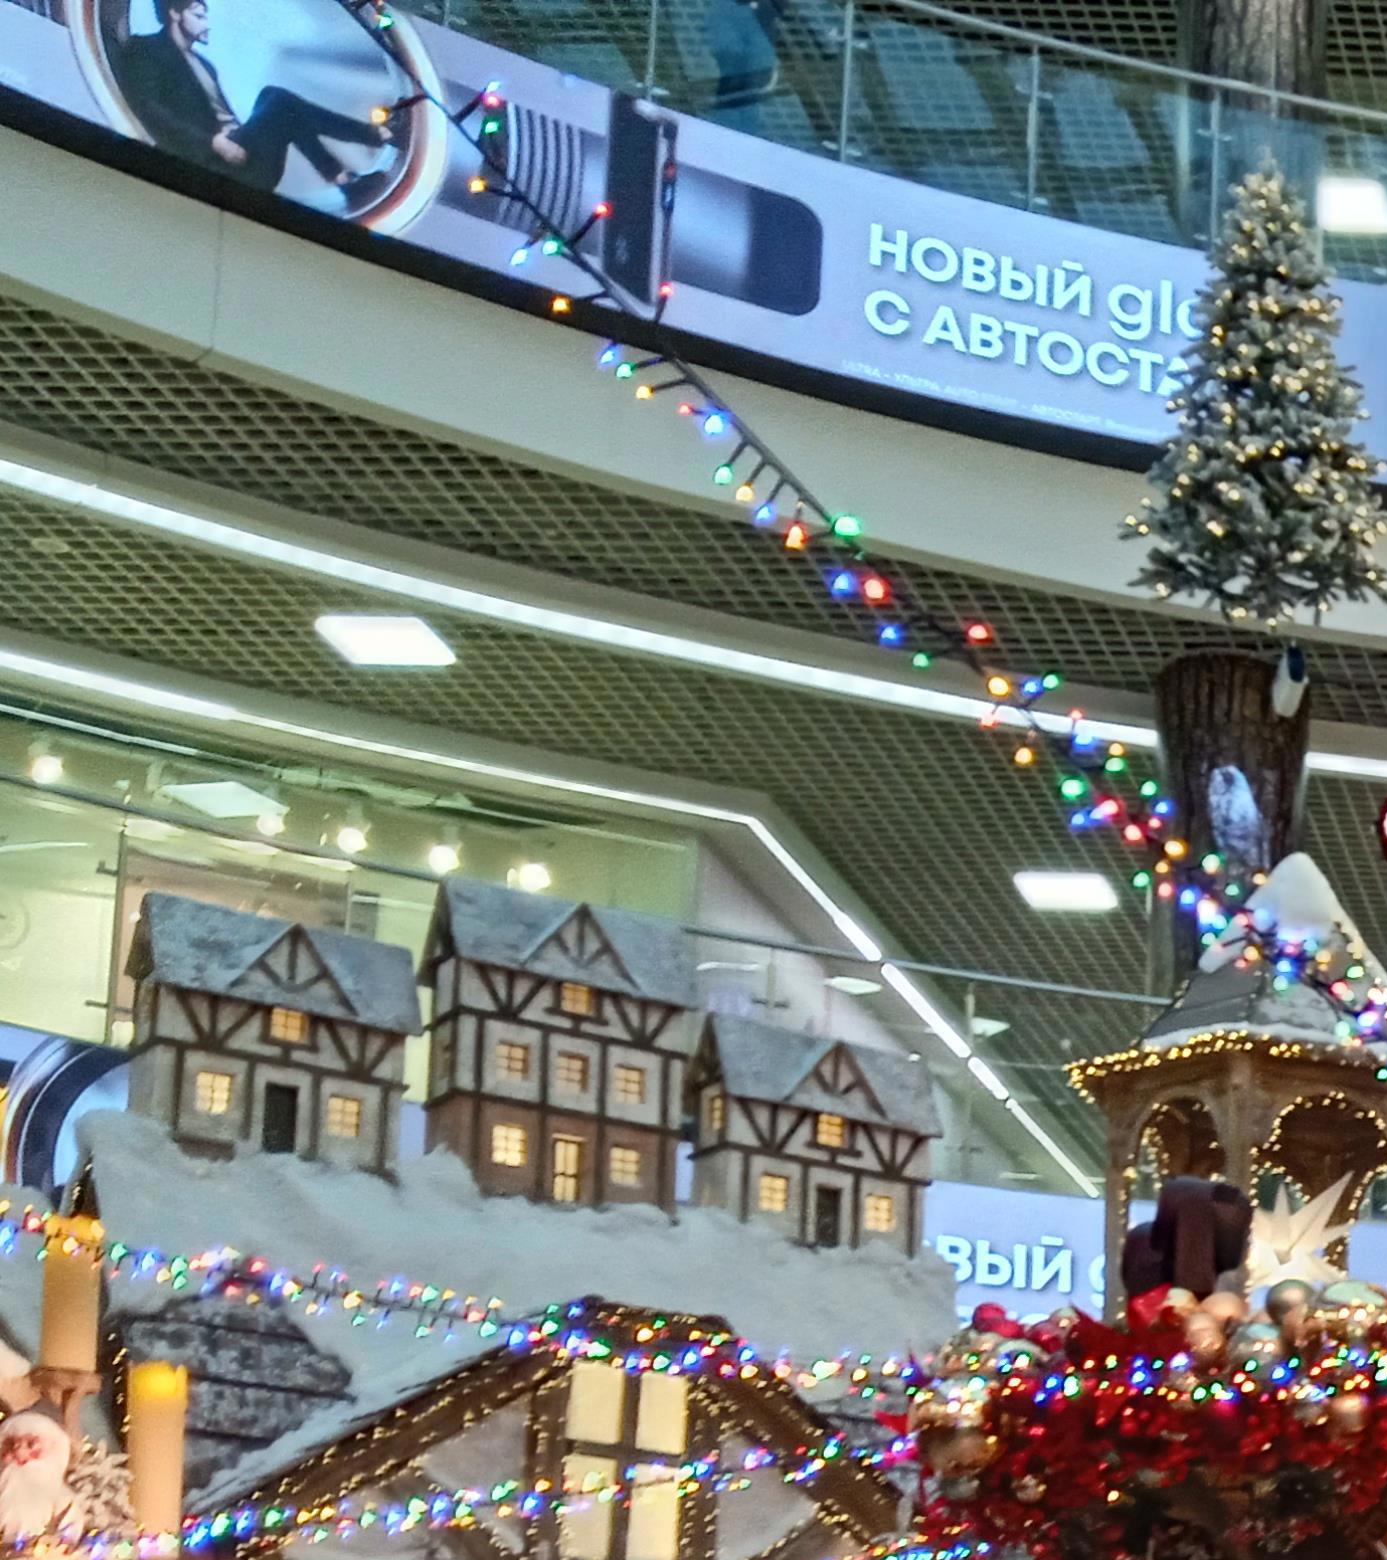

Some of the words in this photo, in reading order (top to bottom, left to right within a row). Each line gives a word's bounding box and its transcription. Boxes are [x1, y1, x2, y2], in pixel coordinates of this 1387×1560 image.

[868, 224, 1092, 316] НОВЫЙ
[864, 290, 911, 335] С
[924, 307, 1193, 398] АВТОСТА
[937, 1234, 1073, 1293] ВЫЙ
